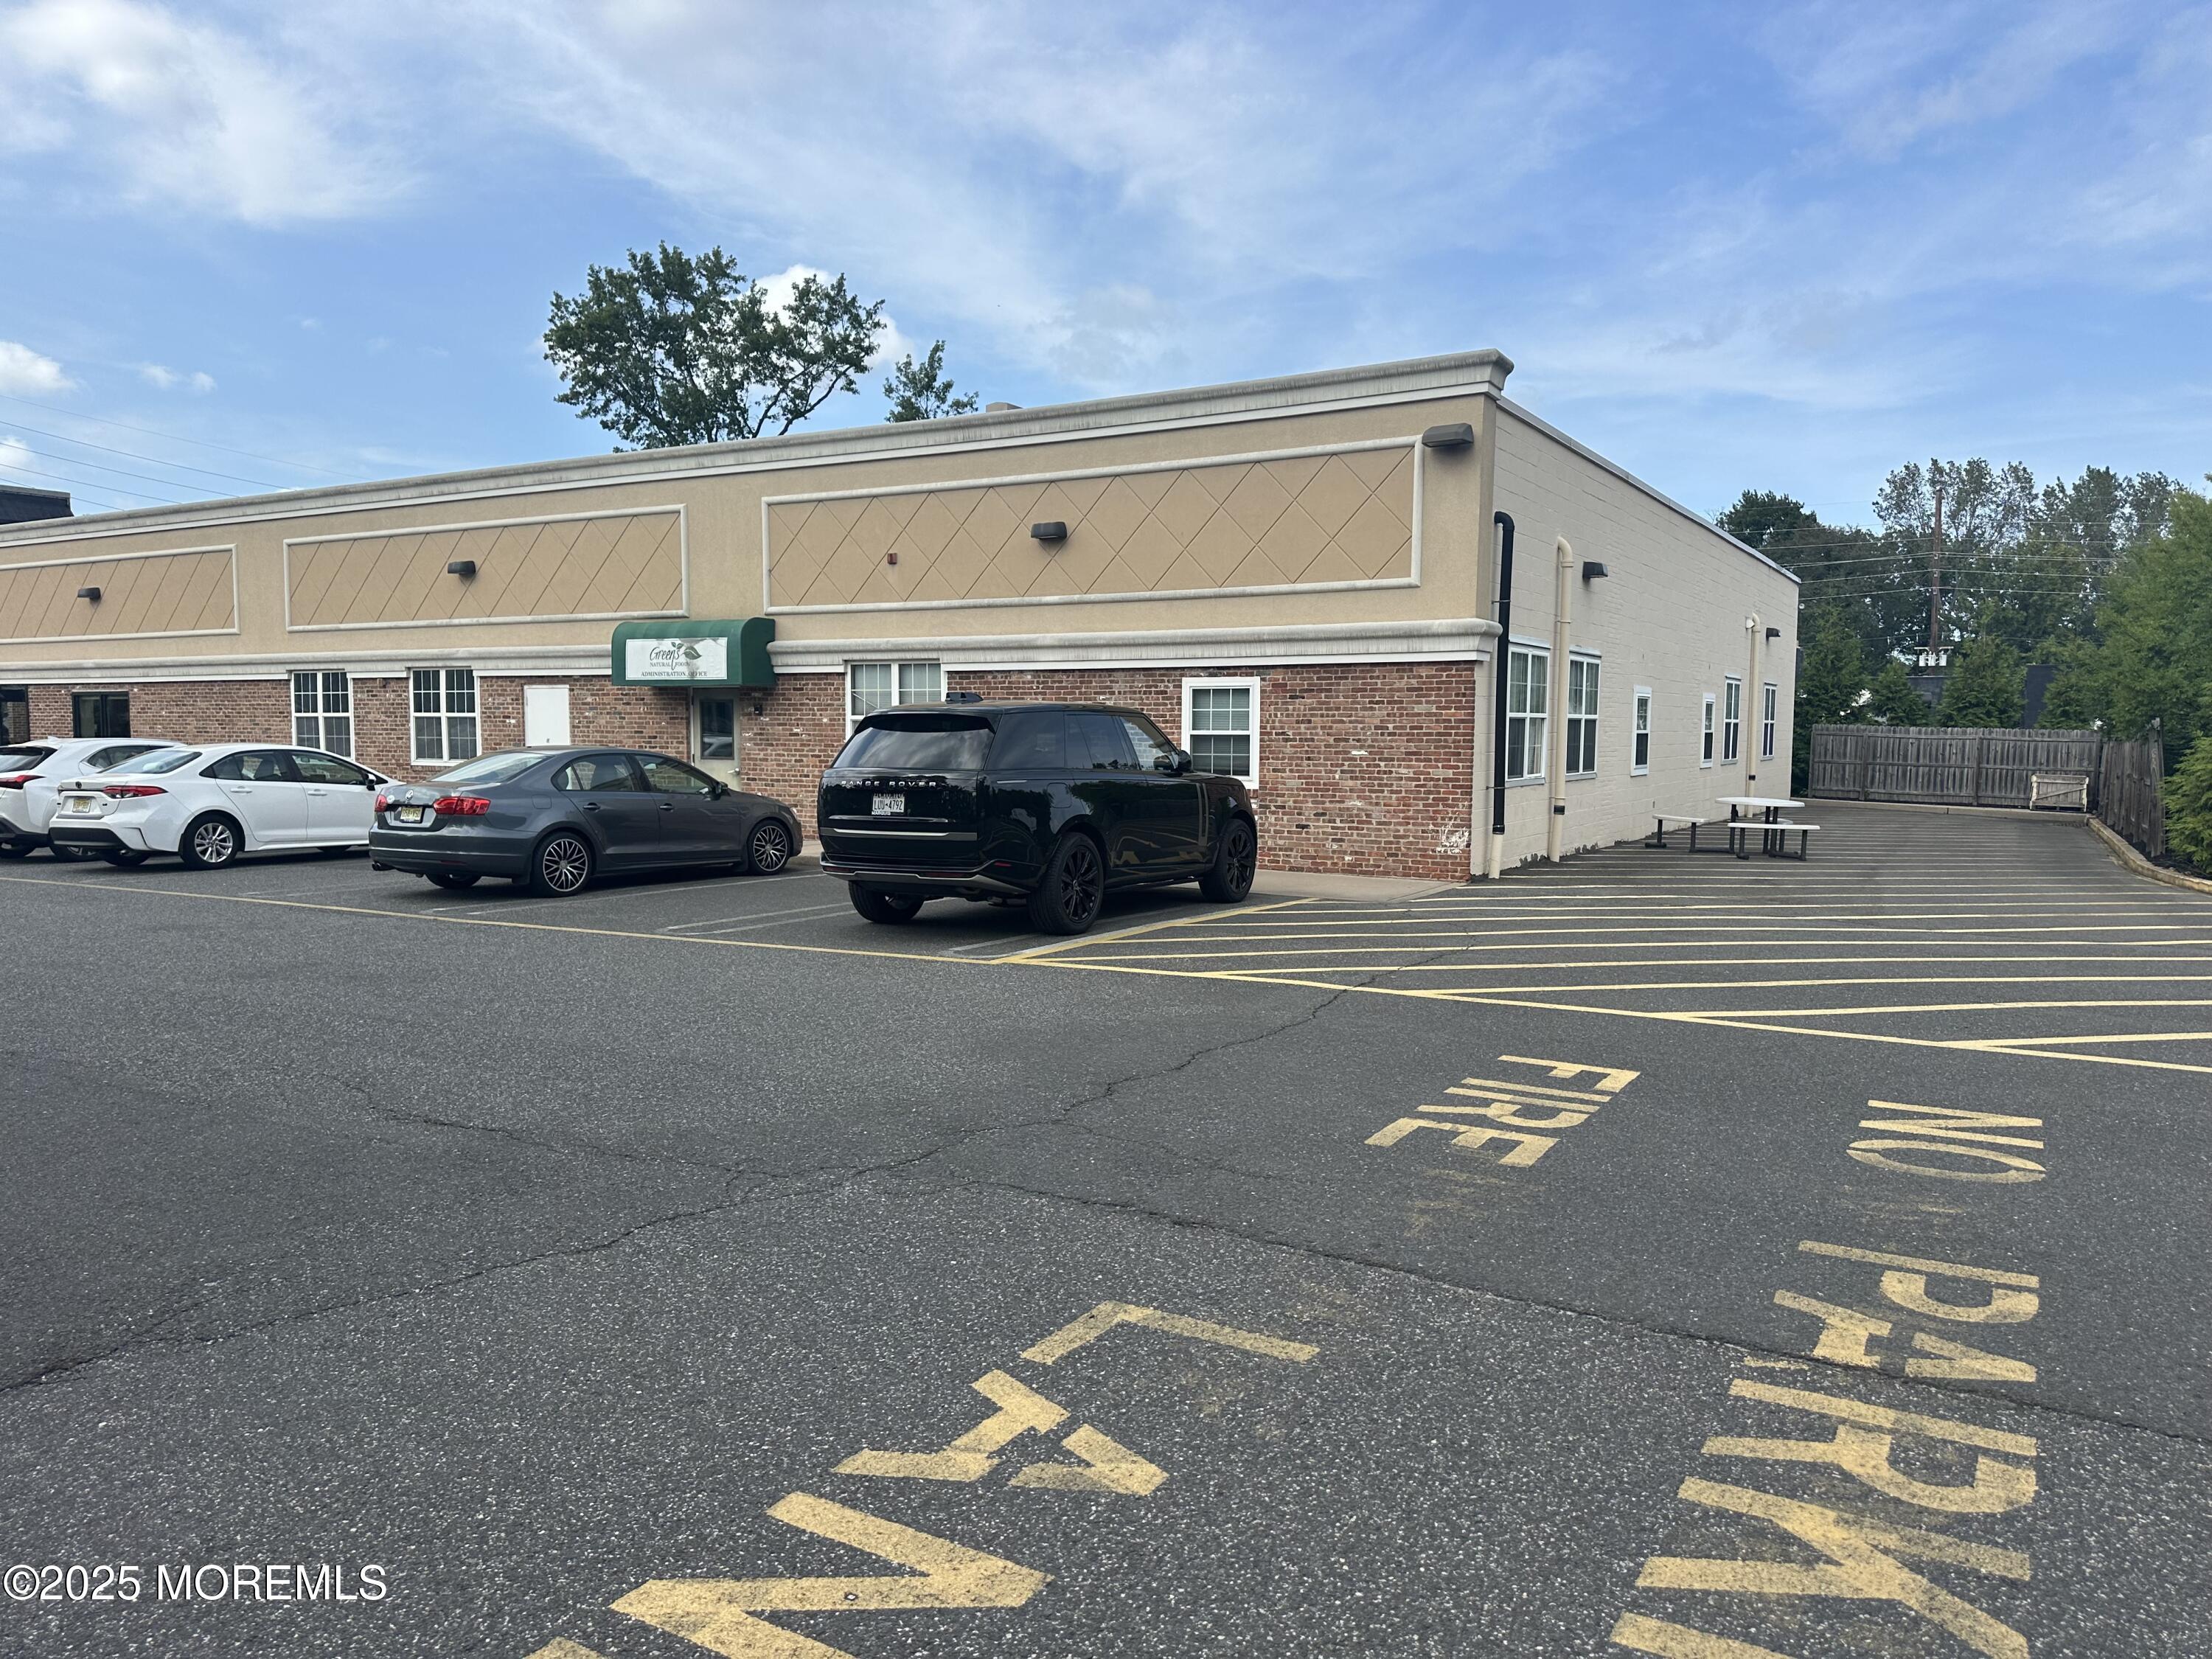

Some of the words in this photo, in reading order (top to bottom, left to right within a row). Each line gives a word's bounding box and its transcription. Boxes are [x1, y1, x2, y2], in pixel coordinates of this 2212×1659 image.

[1365, 1055, 1641, 1167] FIRE
[1846, 1099, 2047, 1181] NO
[519, 1301, 1321, 1659] LAN
